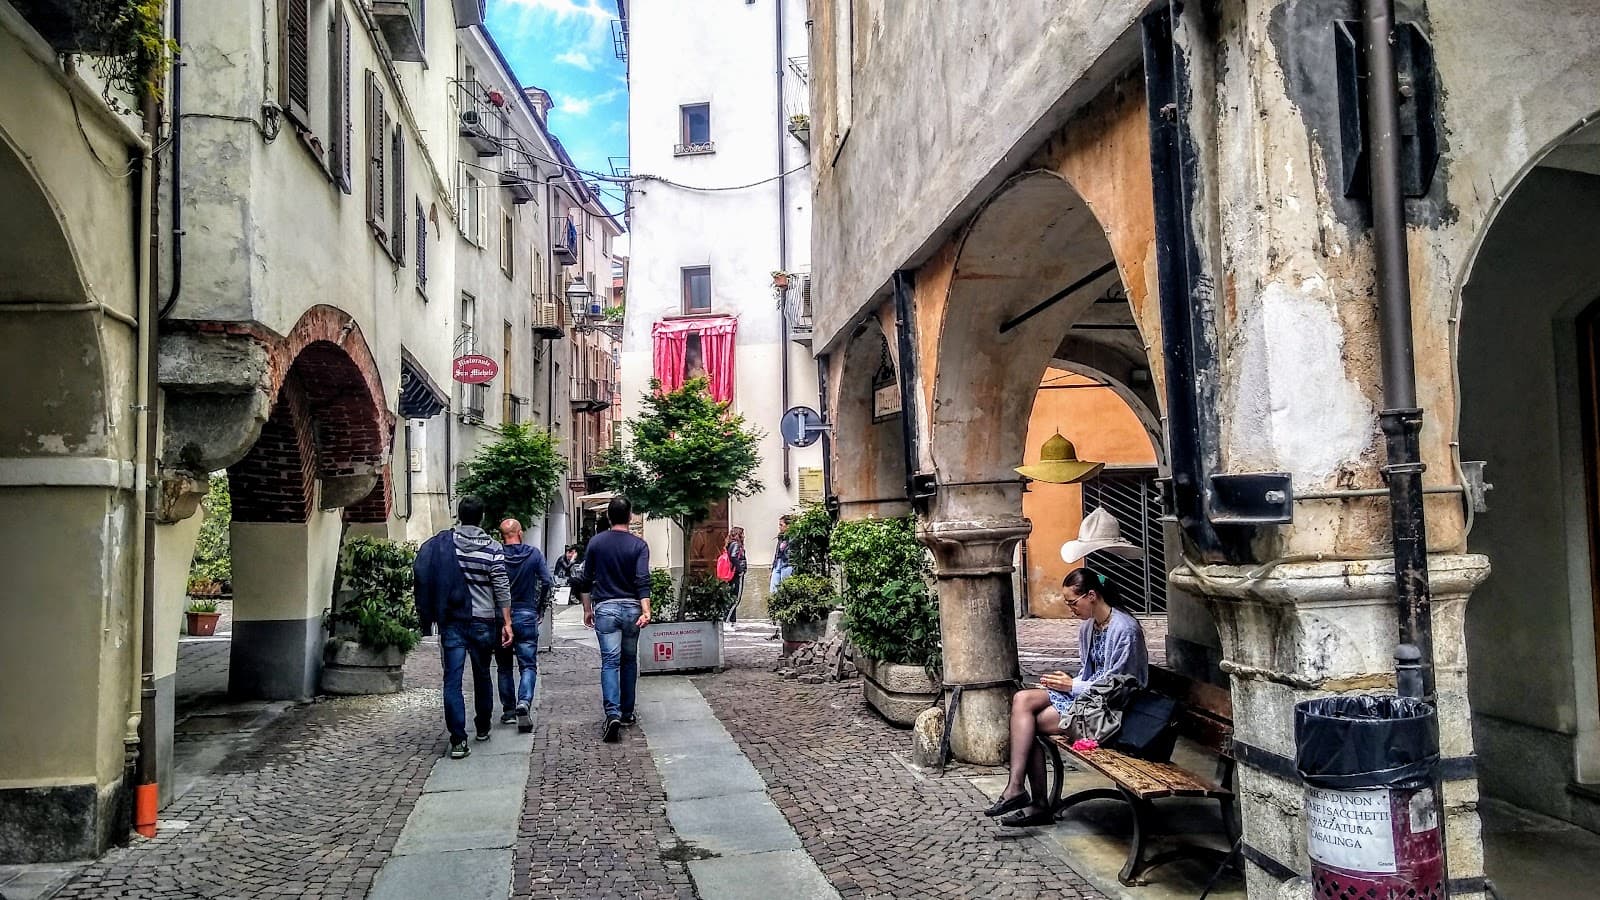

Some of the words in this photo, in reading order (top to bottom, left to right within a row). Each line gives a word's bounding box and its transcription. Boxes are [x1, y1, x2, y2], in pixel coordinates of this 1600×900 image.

[458, 358, 491, 369] Ristorante
[470, 368, 494, 378] Michele
[1331, 793, 1342, 804] DI
[1345, 796, 1372, 806] NON
[1327, 806, 1389, 821] SACCHETTI
[1311, 829, 1363, 849] CASALINGA
